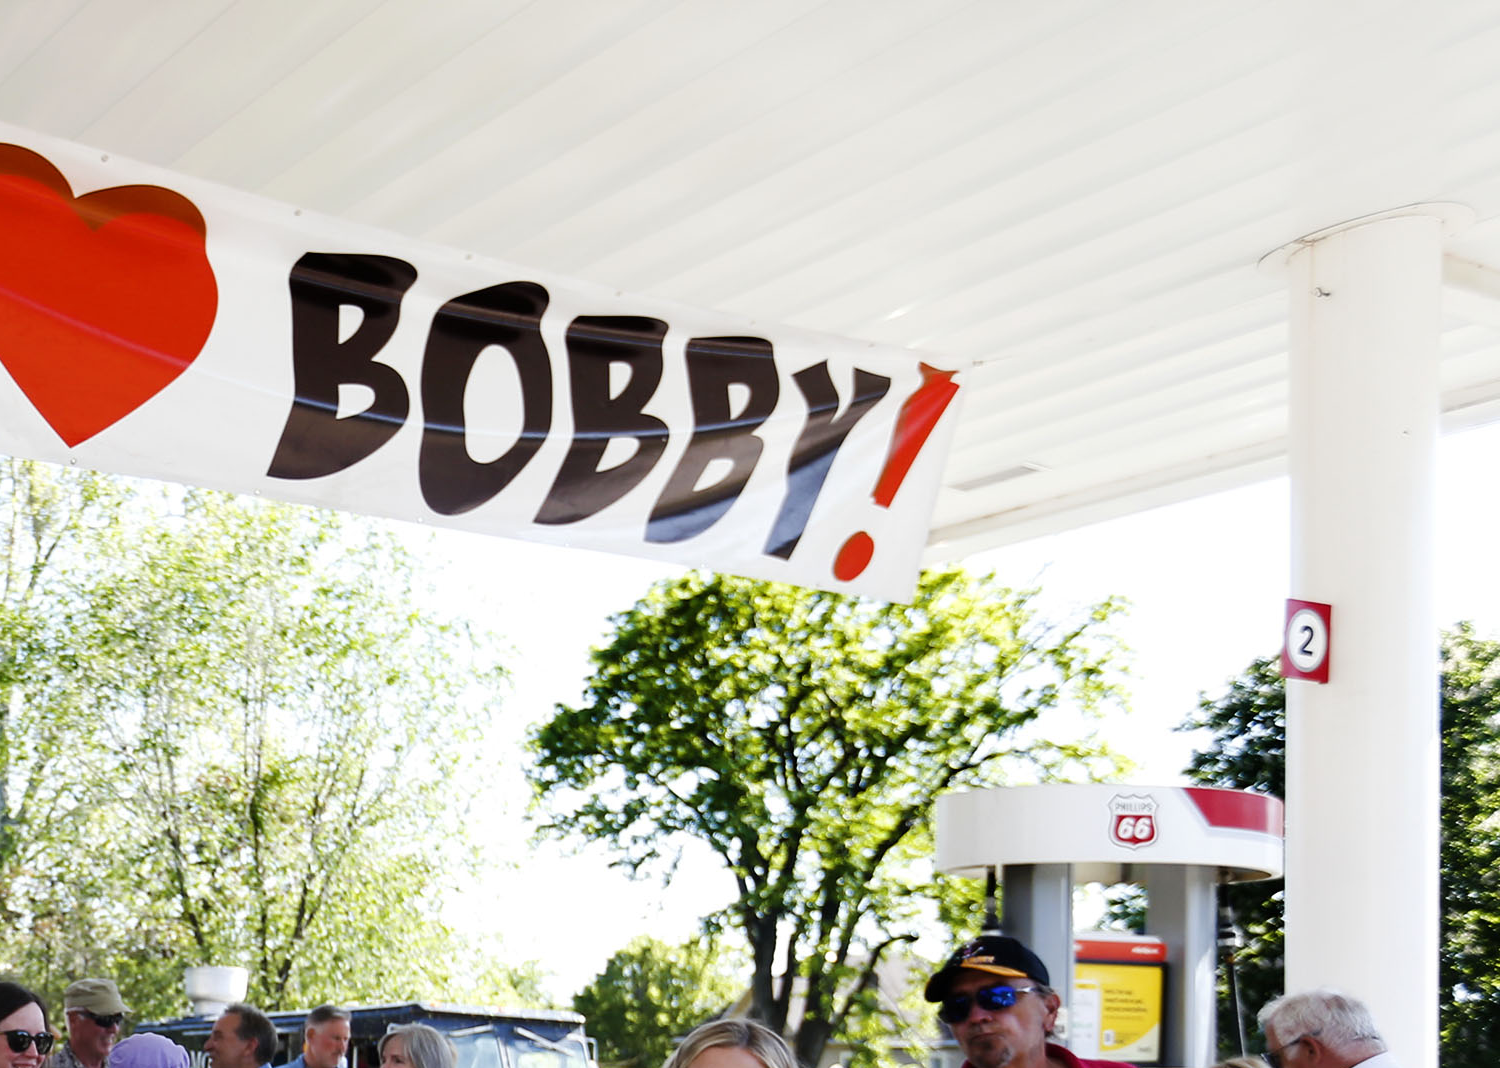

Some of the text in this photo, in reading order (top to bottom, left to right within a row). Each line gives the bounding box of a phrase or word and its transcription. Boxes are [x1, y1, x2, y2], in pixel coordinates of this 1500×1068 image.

[265, 251, 961, 582] BOBBY!
[1299, 625, 1314, 656] 2
[1117, 817, 1151, 839] 66
